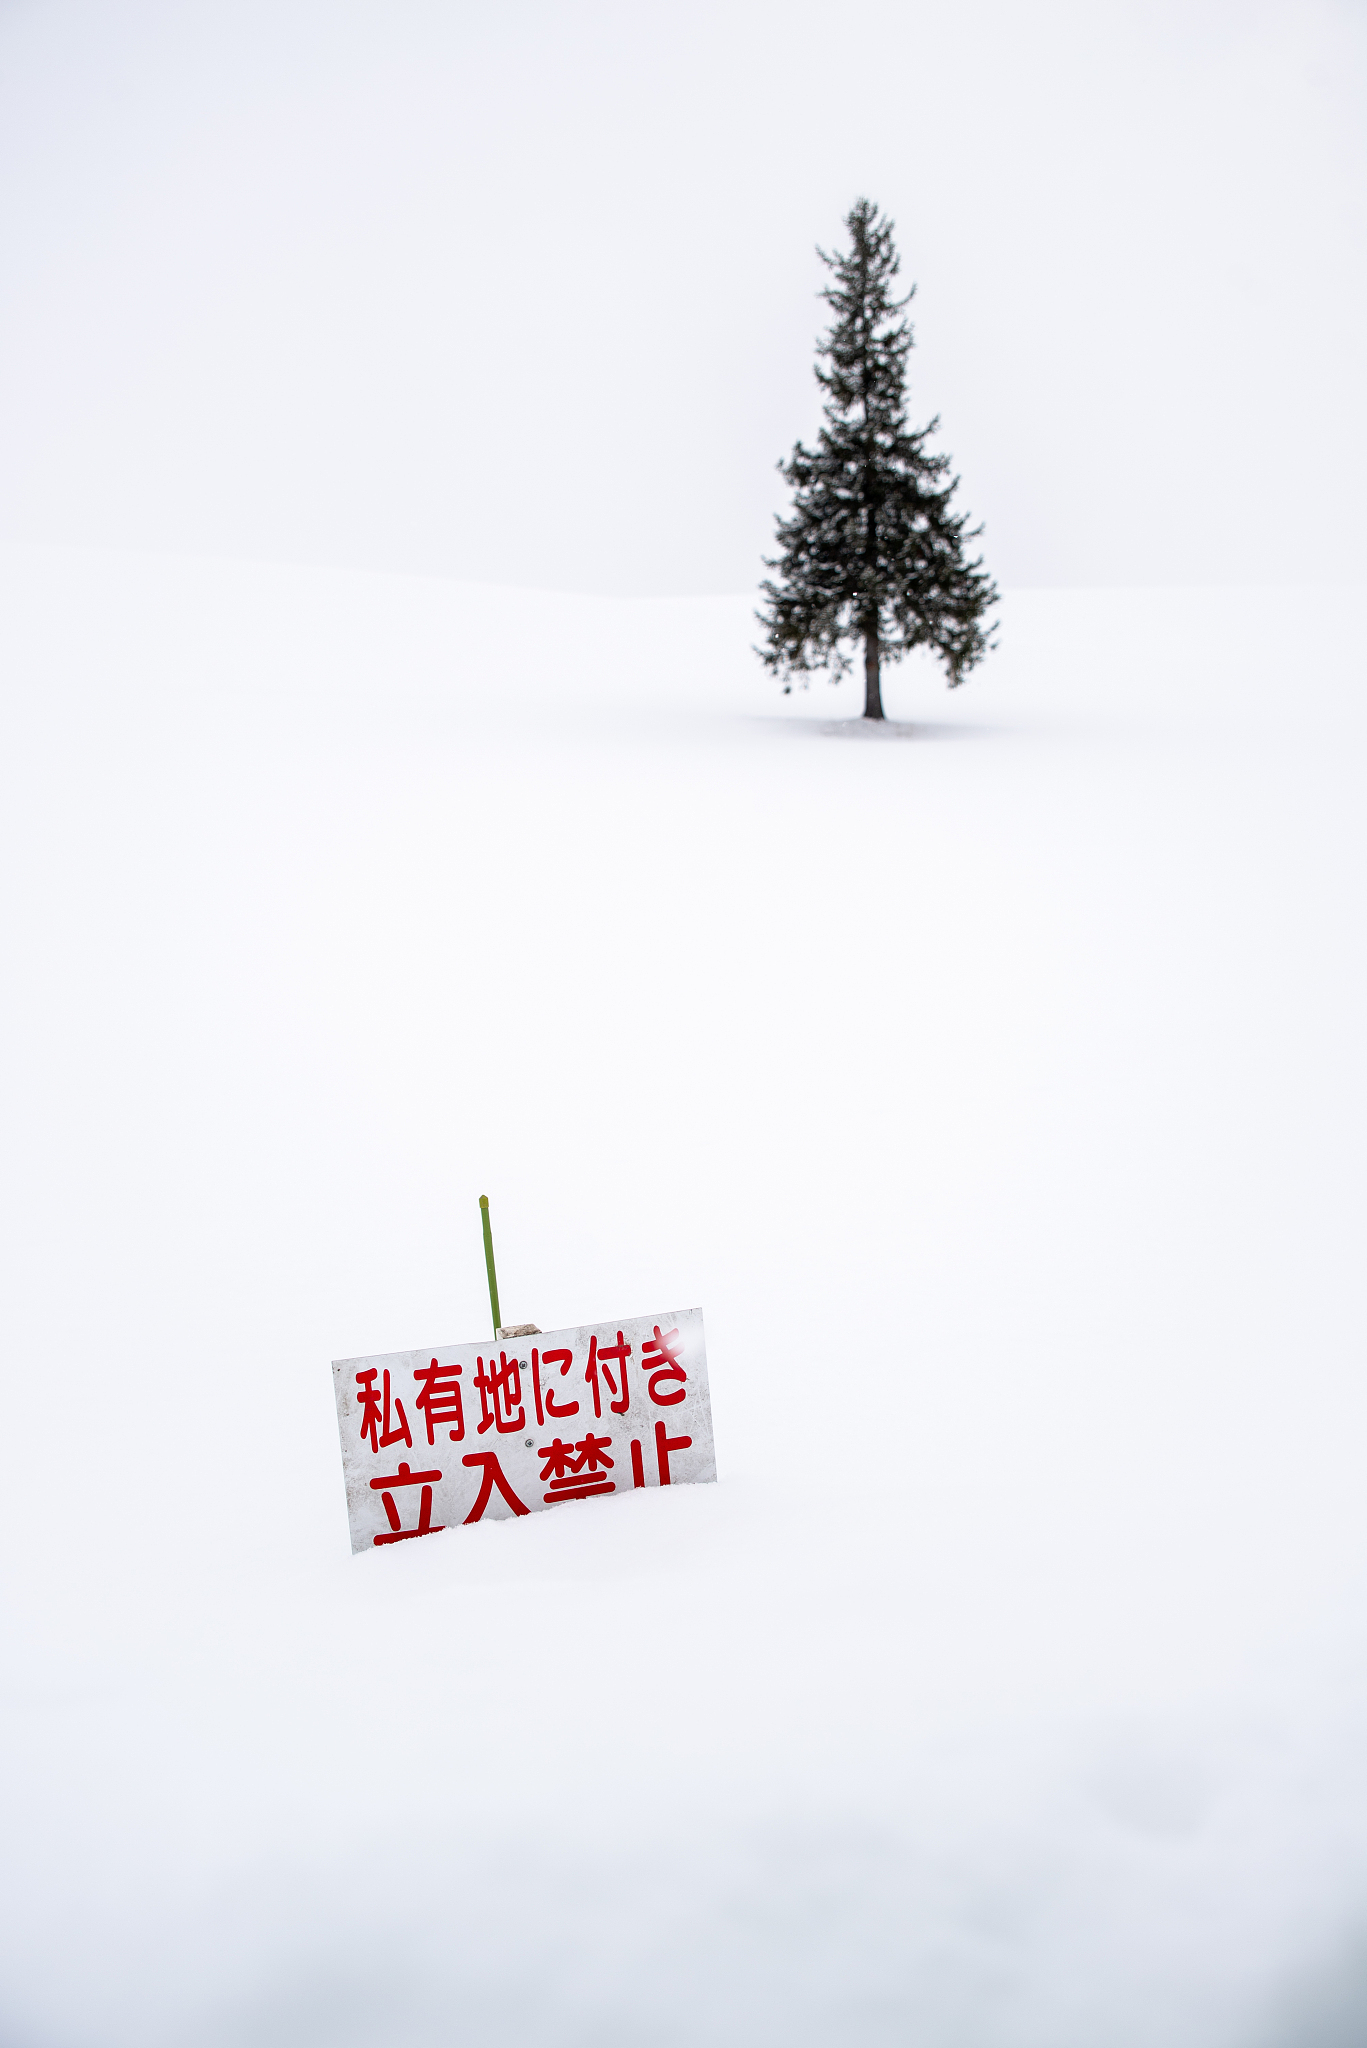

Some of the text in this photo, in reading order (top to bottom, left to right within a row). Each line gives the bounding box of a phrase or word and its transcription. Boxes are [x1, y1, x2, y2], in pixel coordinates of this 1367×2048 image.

[355, 1325, 687, 1454] 私有地に付き
